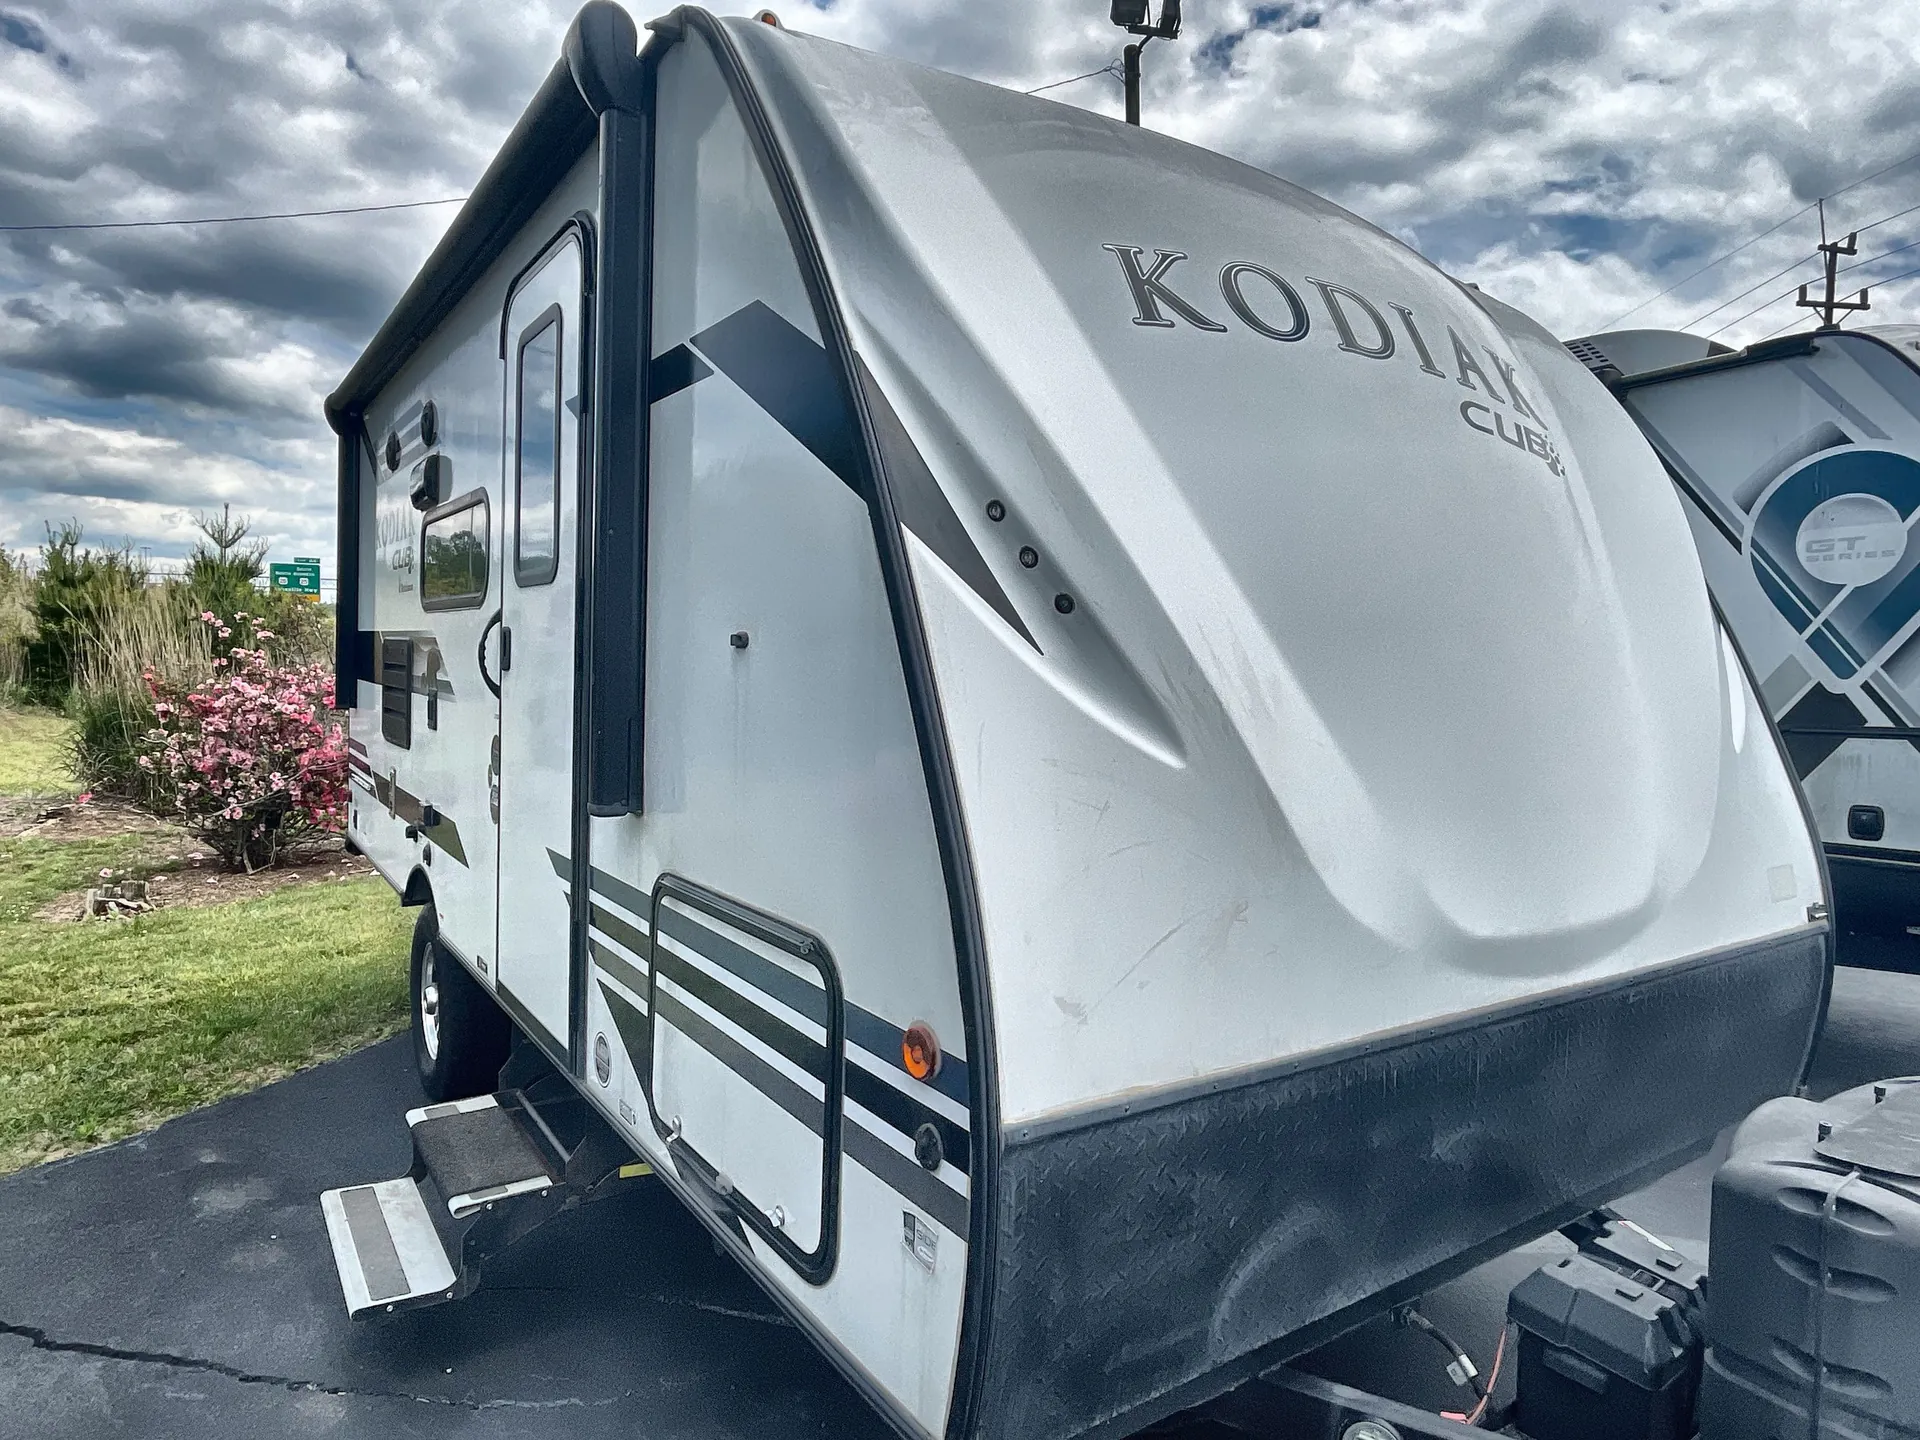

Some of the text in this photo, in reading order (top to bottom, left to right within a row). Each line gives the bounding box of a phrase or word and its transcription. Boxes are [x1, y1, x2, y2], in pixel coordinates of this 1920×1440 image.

[1102, 242, 1548, 431] KODIAK
[1459, 400, 1551, 463] CUB
[1806, 535, 1867, 553] GT
[1806, 550, 1896, 562] SERIES
